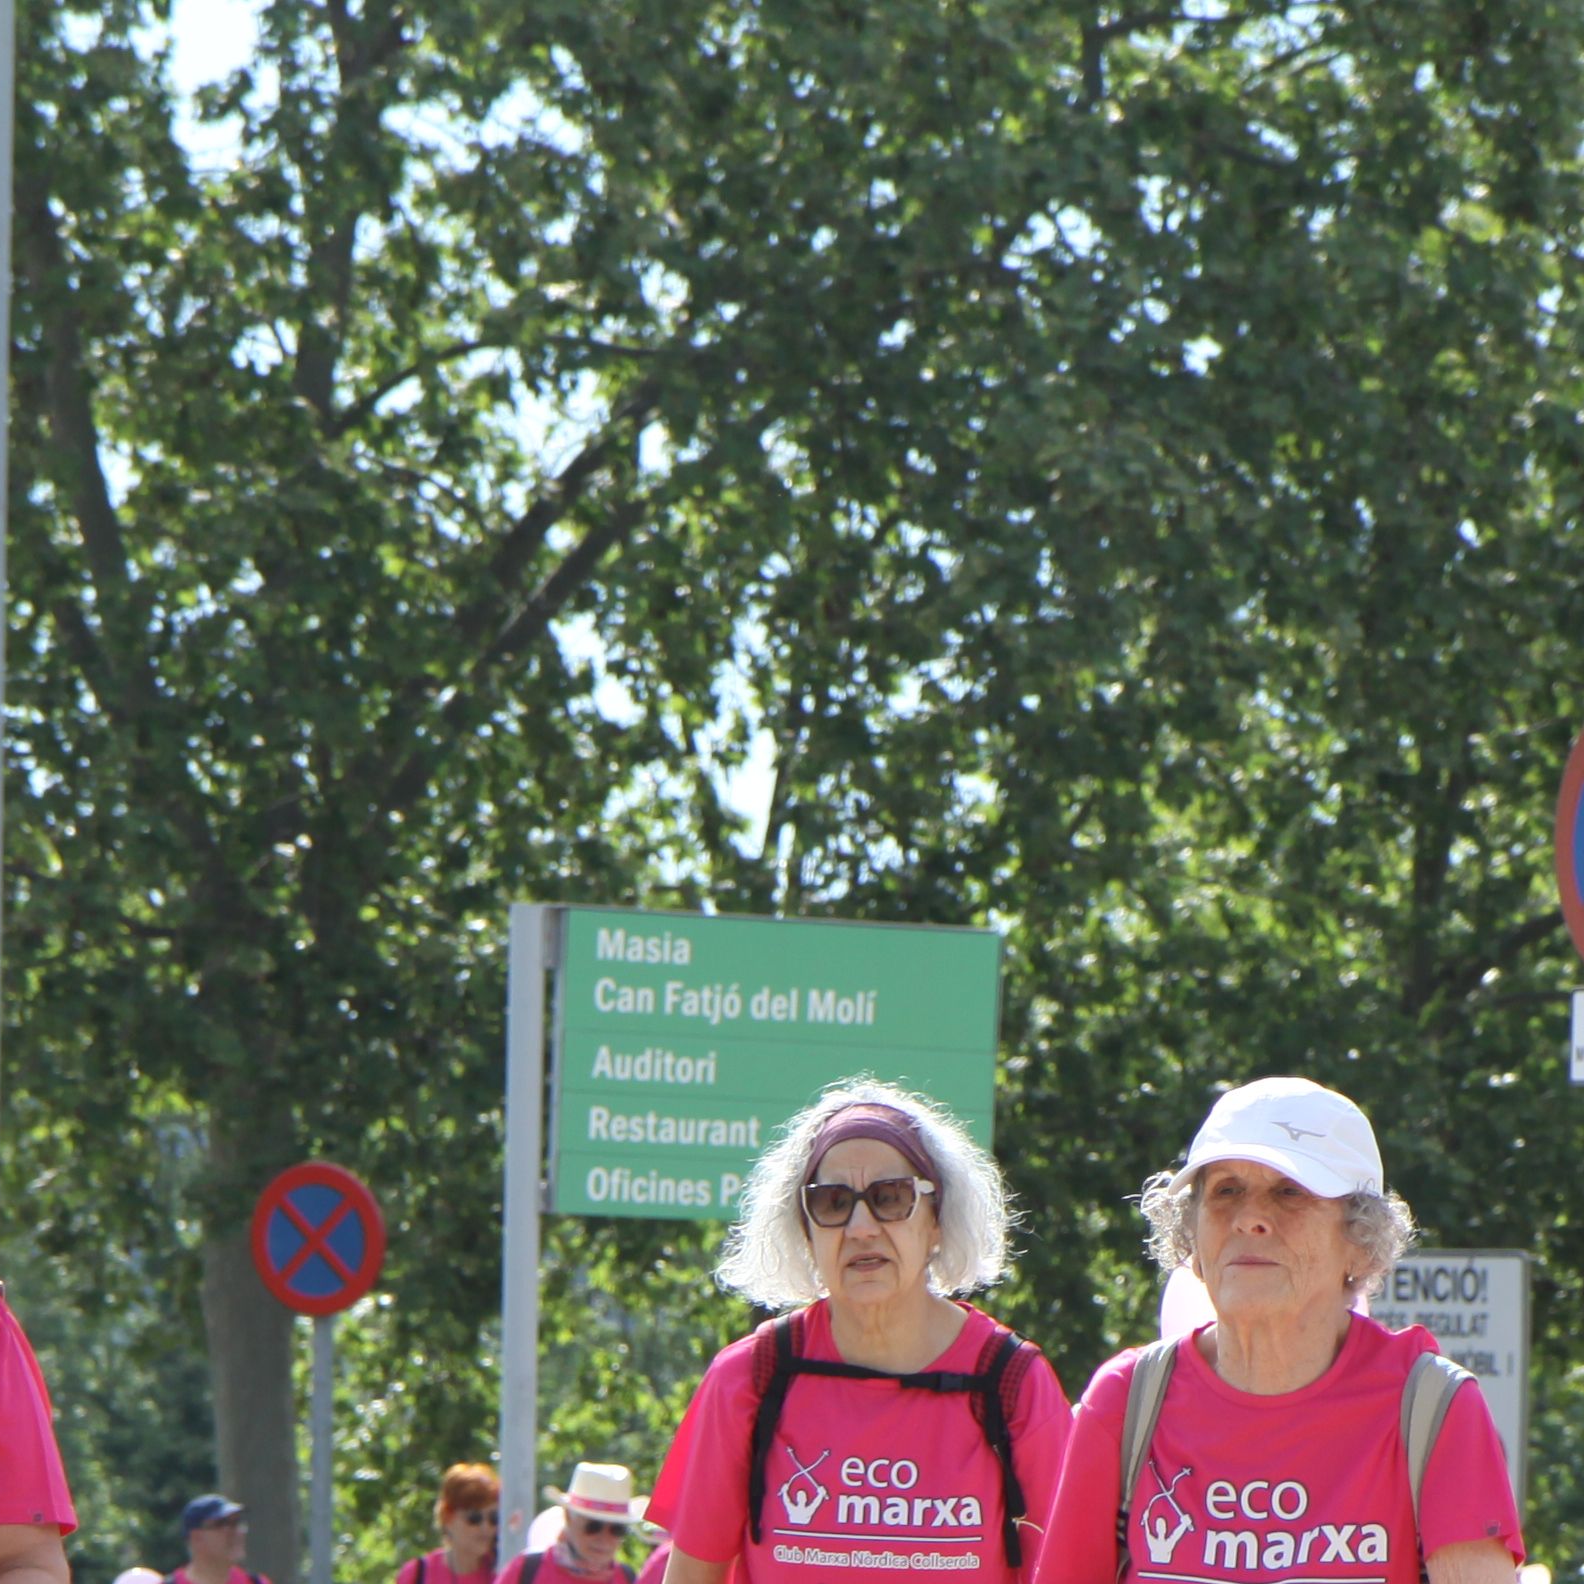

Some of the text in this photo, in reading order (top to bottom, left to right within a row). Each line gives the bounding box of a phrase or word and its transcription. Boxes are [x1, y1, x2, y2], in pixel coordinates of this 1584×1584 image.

[596, 928, 691, 966] Masia
[594, 977, 878, 1026] Can Fatjó del Molí
[592, 1045, 717, 1085] Auditori
[588, 1106, 760, 1149] Restaurant
[587, 1166, 711, 1206] Oficines
[840, 1456, 919, 1489] eco
[836, 1494, 982, 1527] marxa
[1205, 1480, 1308, 1521] eco
[773, 1545, 980, 1569] Club Marxa Nòrdica Collserola
[1202, 1522, 1388, 1569] marxa
